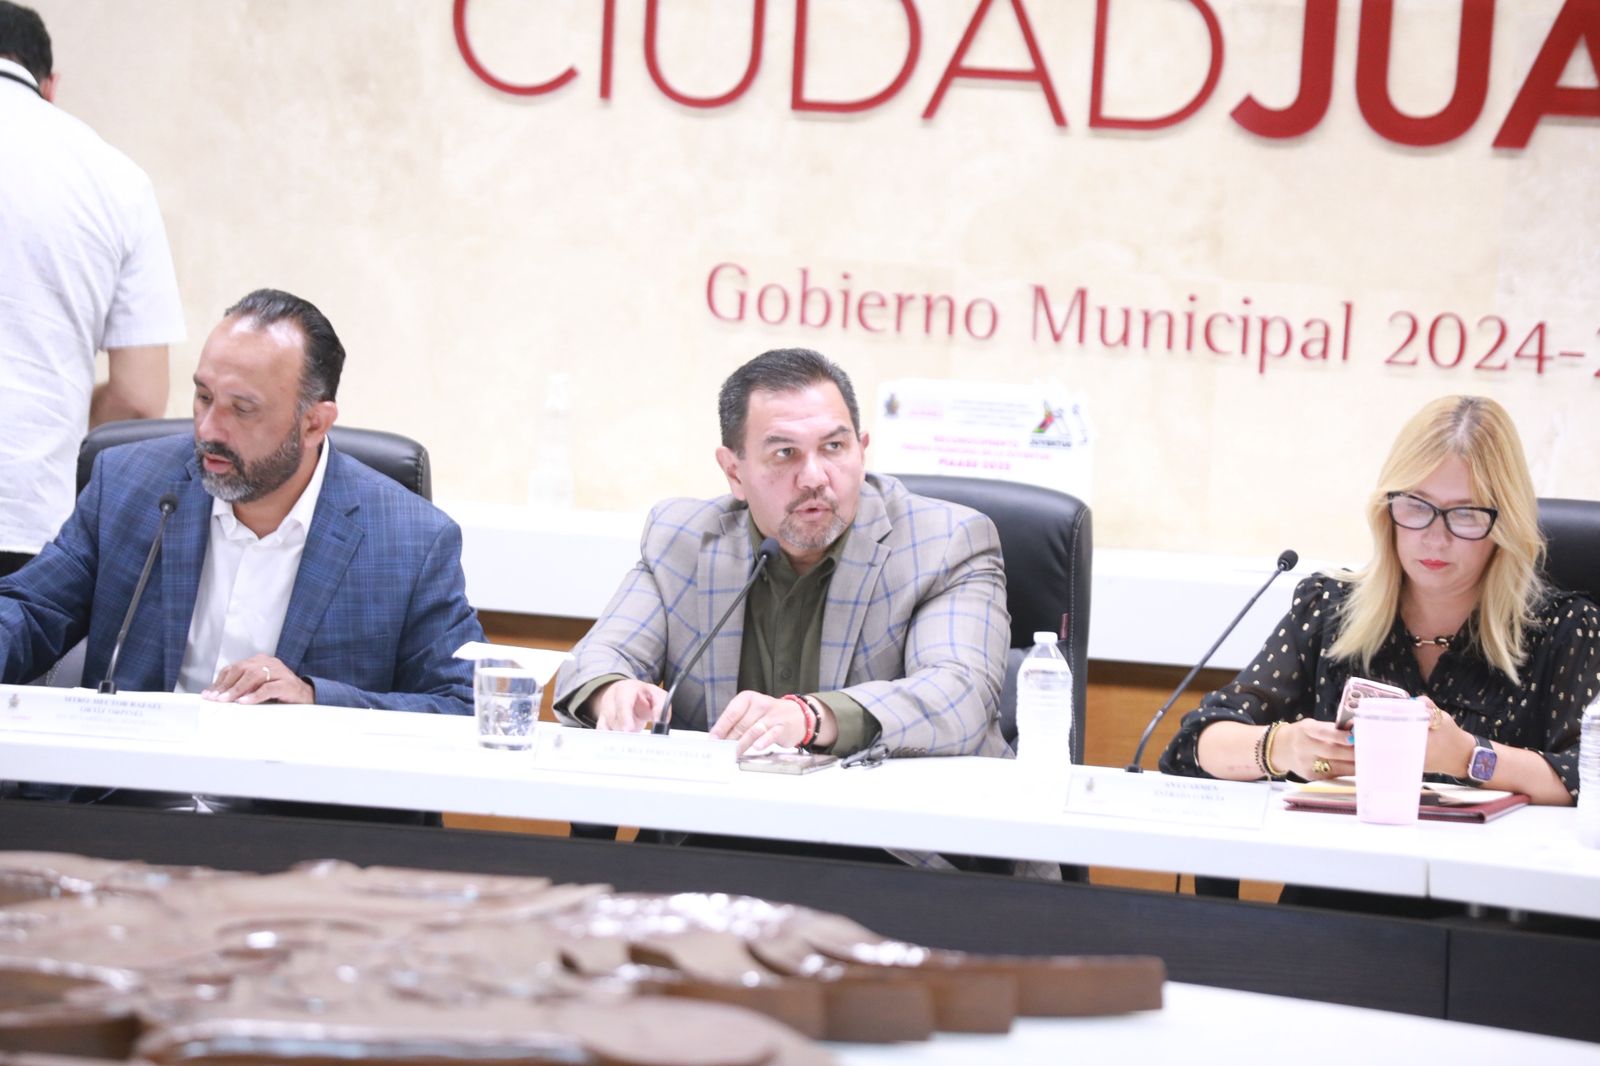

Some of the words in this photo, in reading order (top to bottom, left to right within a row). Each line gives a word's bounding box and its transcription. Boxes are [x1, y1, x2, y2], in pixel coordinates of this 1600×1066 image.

[706, 262, 999, 341] Gobierno
[1030, 284, 1353, 375] Municipal
[1384, 310, 1600, 376] 2024-
